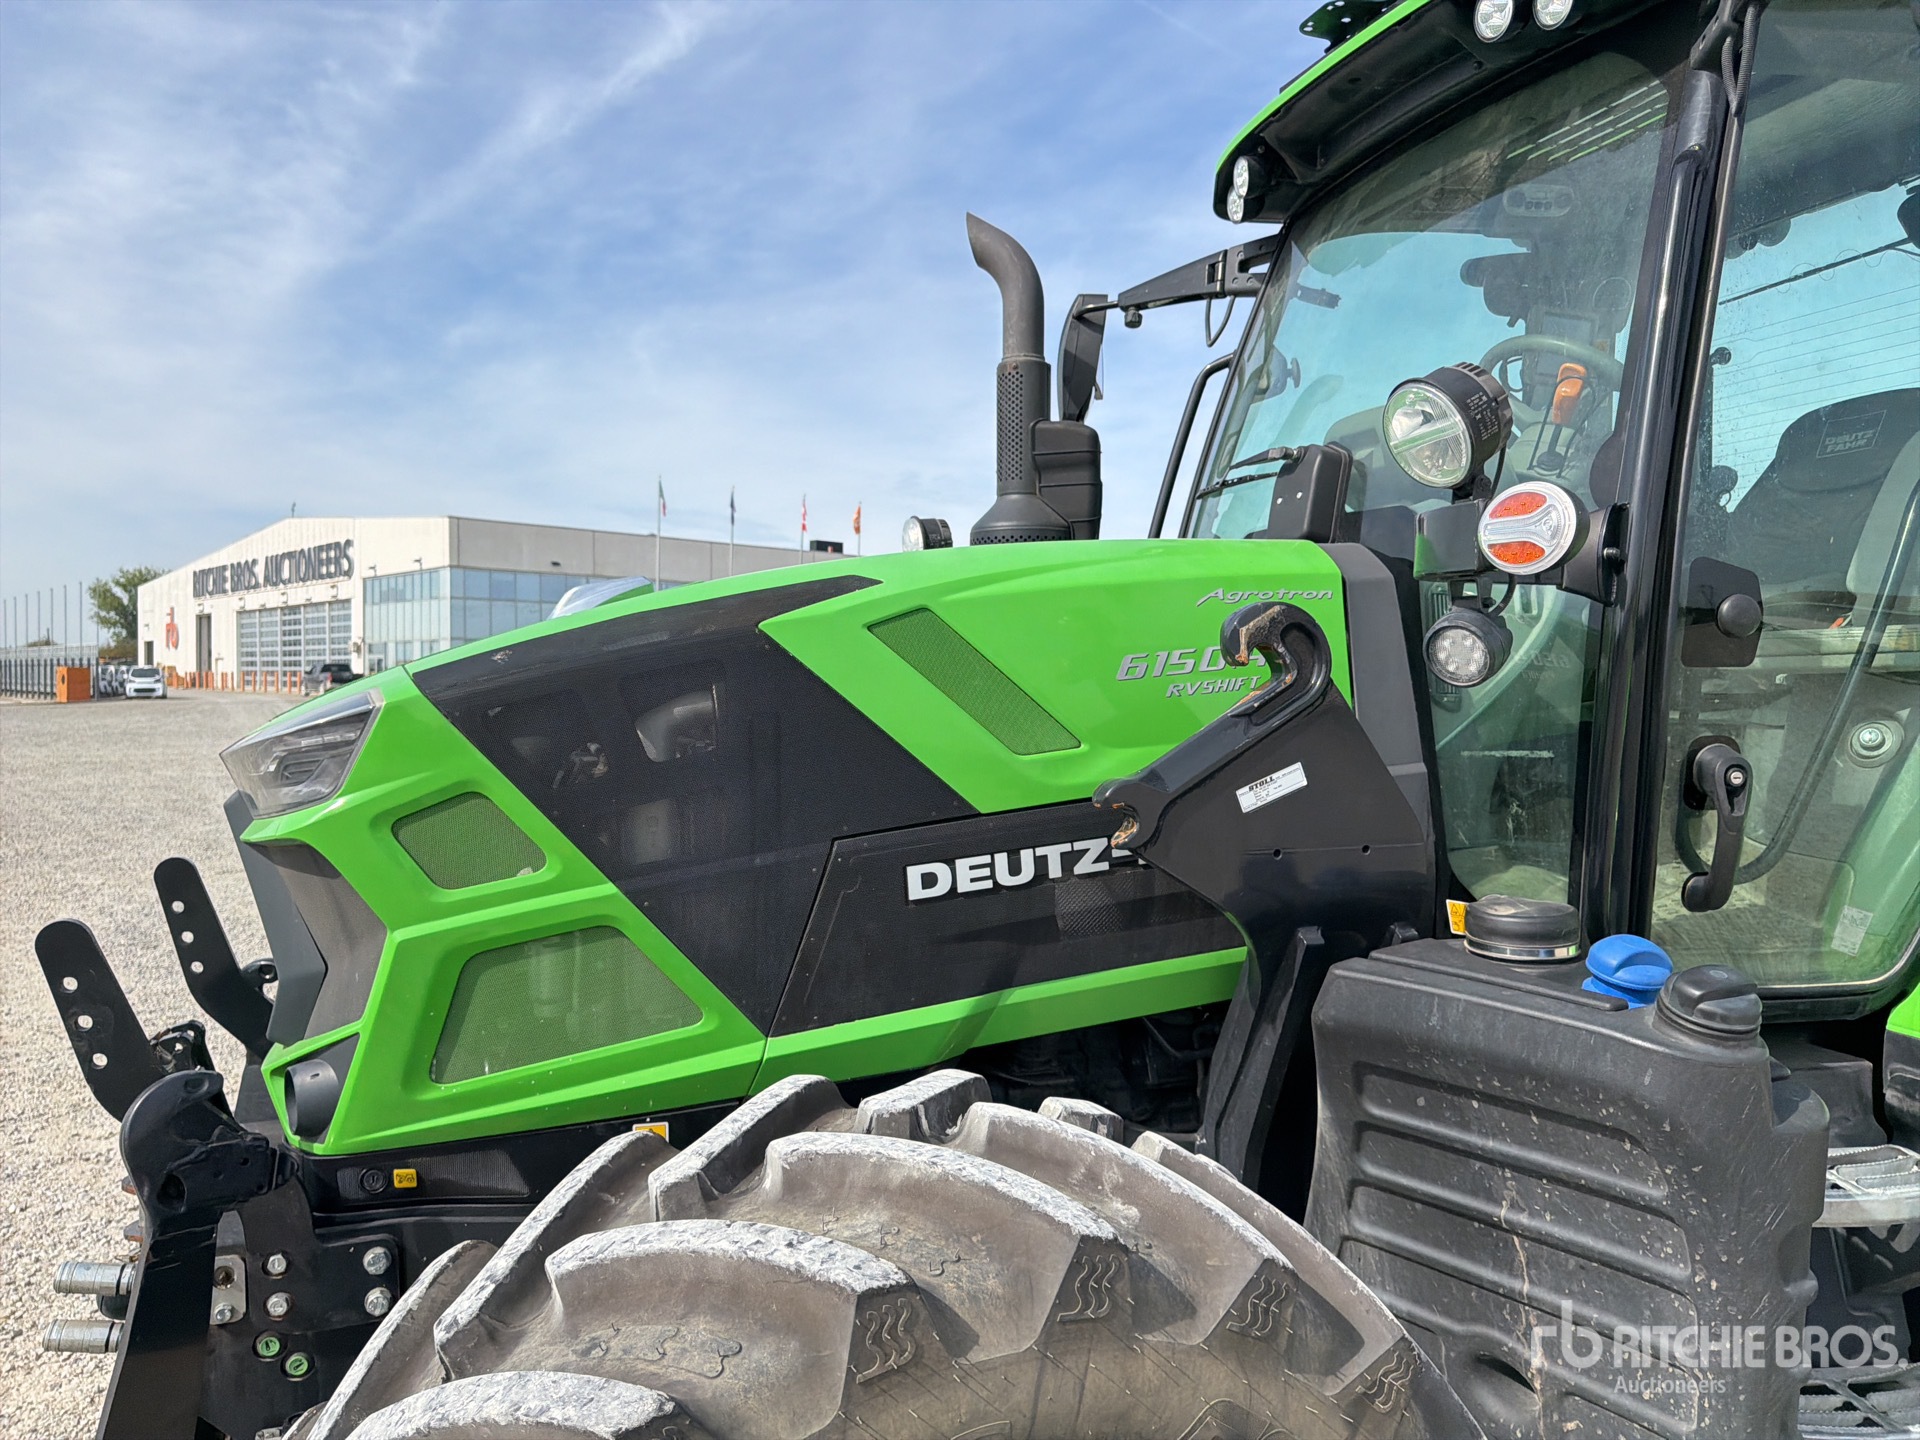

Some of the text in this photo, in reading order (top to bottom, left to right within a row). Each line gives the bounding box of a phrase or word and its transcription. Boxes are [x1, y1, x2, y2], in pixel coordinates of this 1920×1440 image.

[193, 539, 354, 598] RITCHIE BROS. AUCTIONEERS
[1196, 588, 1333, 607] Agrotron
[1166, 675, 1261, 698] RVSHIFT
[1248, 775, 1275, 792] STOLL
[906, 836, 1148, 901] DEUTZ-
